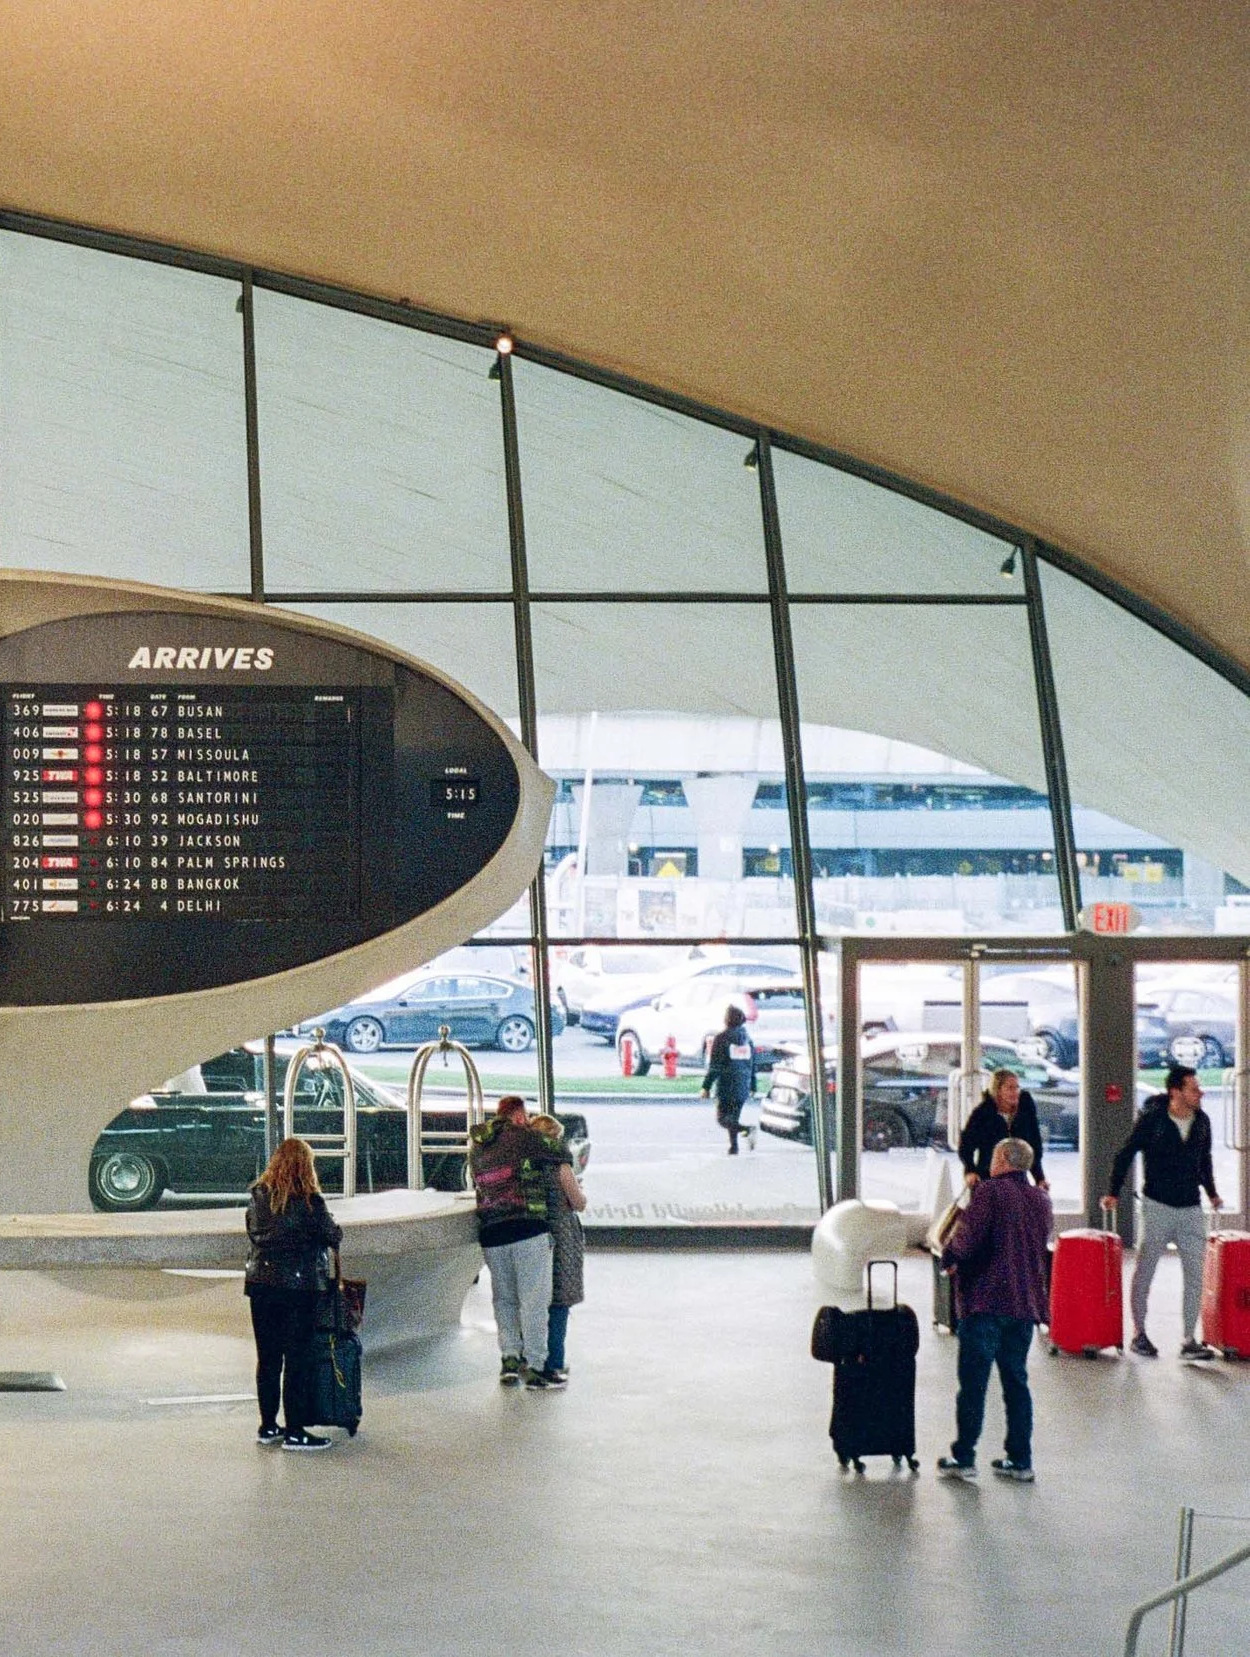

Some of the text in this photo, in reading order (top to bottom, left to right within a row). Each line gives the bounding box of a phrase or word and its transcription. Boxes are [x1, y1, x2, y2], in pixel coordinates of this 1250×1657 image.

[127, 646, 274, 670] ARRIVES
[14, 705, 39, 716] 369
[107, 705, 140, 716] 5:18
[152, 706, 167, 717] 67
[178, 706, 222, 717] BUSAN
[14, 727, 39, 738] 406
[107, 727, 140, 738] 5:18
[152, 727, 167, 738] 78
[178, 728, 220, 739] BASEL
[13, 748, 248, 760] 009 5:18 57 MISSOULA
[13, 770, 39, 781] 925
[107, 770, 140, 781] 5:18
[152, 770, 167, 782] 52
[178, 771, 257, 782] BALTIMORE
[14, 792, 39, 803] 525
[107, 792, 140, 803] 5:30
[151, 792, 167, 803] 68
[178, 792, 256, 803] SANTORINI
[446, 788, 474, 800] 5:15
[13, 813, 39, 825] 020
[107, 814, 140, 825] 5:30
[151, 814, 167, 824] 92
[178, 814, 258, 825] MOGADISHU
[13, 835, 39, 847] 826
[107, 835, 140, 846] 6:10
[152, 835, 168, 846] 39
[180, 835, 239, 846] JACKSON
[14, 857, 38, 868] 204
[107, 857, 140, 868] 6:10
[151, 857, 167, 868] 84
[178, 857, 213, 868] PALM
[224, 857, 284, 868] SPRINGS
[13, 879, 37, 890] 401
[107, 879, 140, 889] 6:24
[151, 879, 167, 889] 88
[178, 879, 239, 889] BANGKOK
[13, 900, 220, 912] 775 6:24 4 DELHI
[1094, 903, 1127, 932] EXIT
